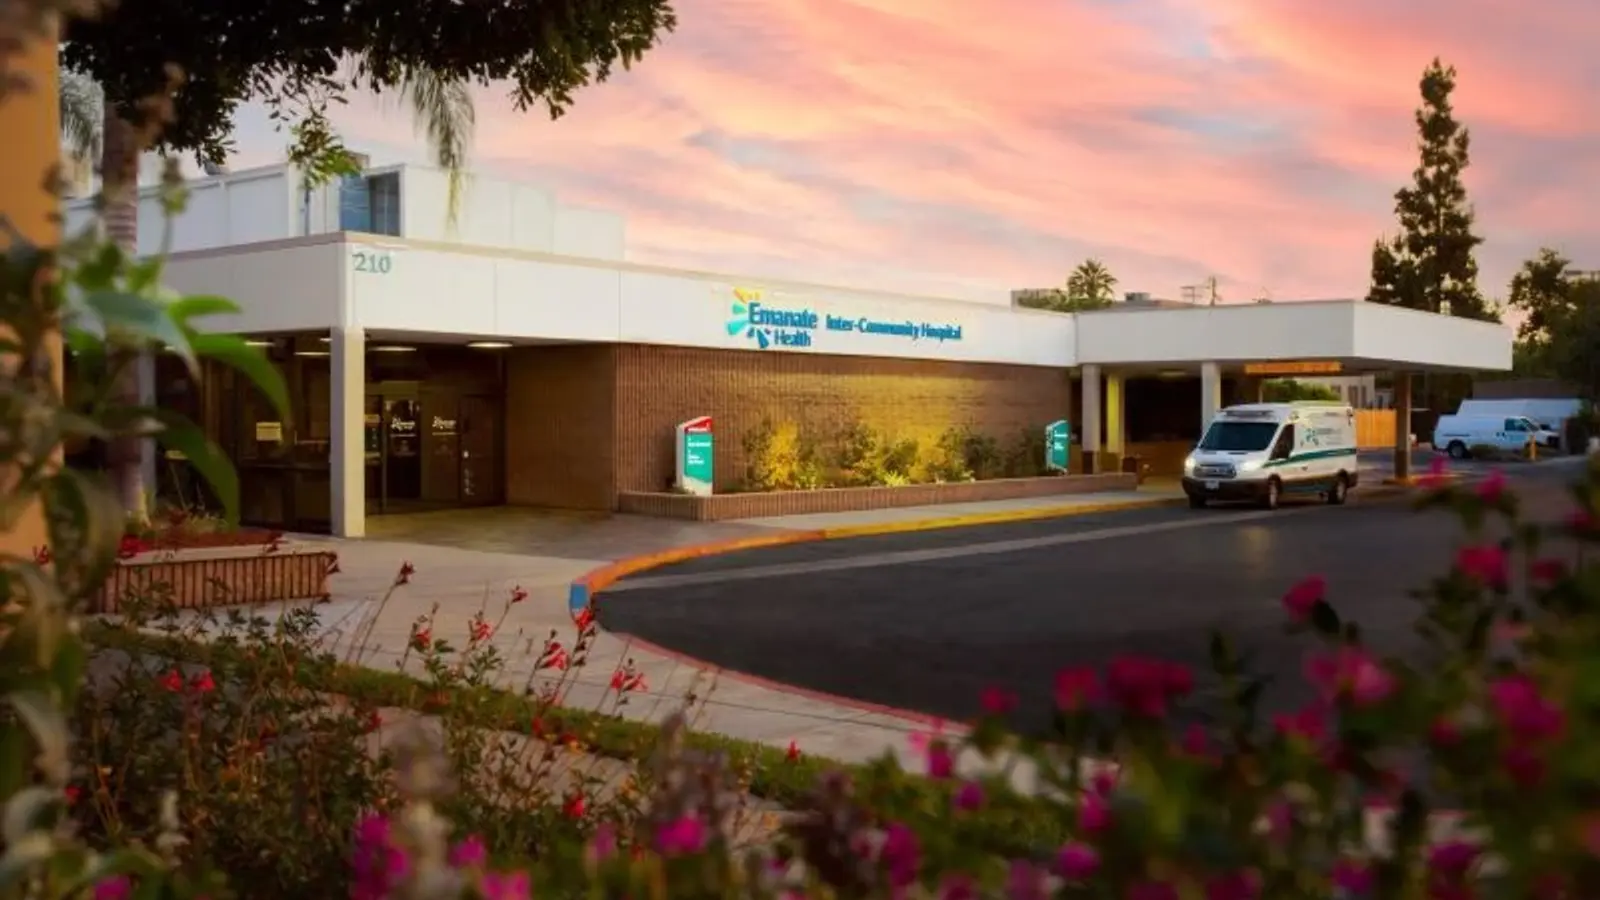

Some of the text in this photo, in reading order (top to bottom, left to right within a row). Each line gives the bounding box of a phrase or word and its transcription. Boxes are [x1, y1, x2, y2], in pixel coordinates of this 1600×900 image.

[352, 252, 392, 274] 210
[749, 302, 818, 329] Emanate
[826, 313, 962, 342] Inter-Community Hospital
[774, 328, 811, 347] Health
